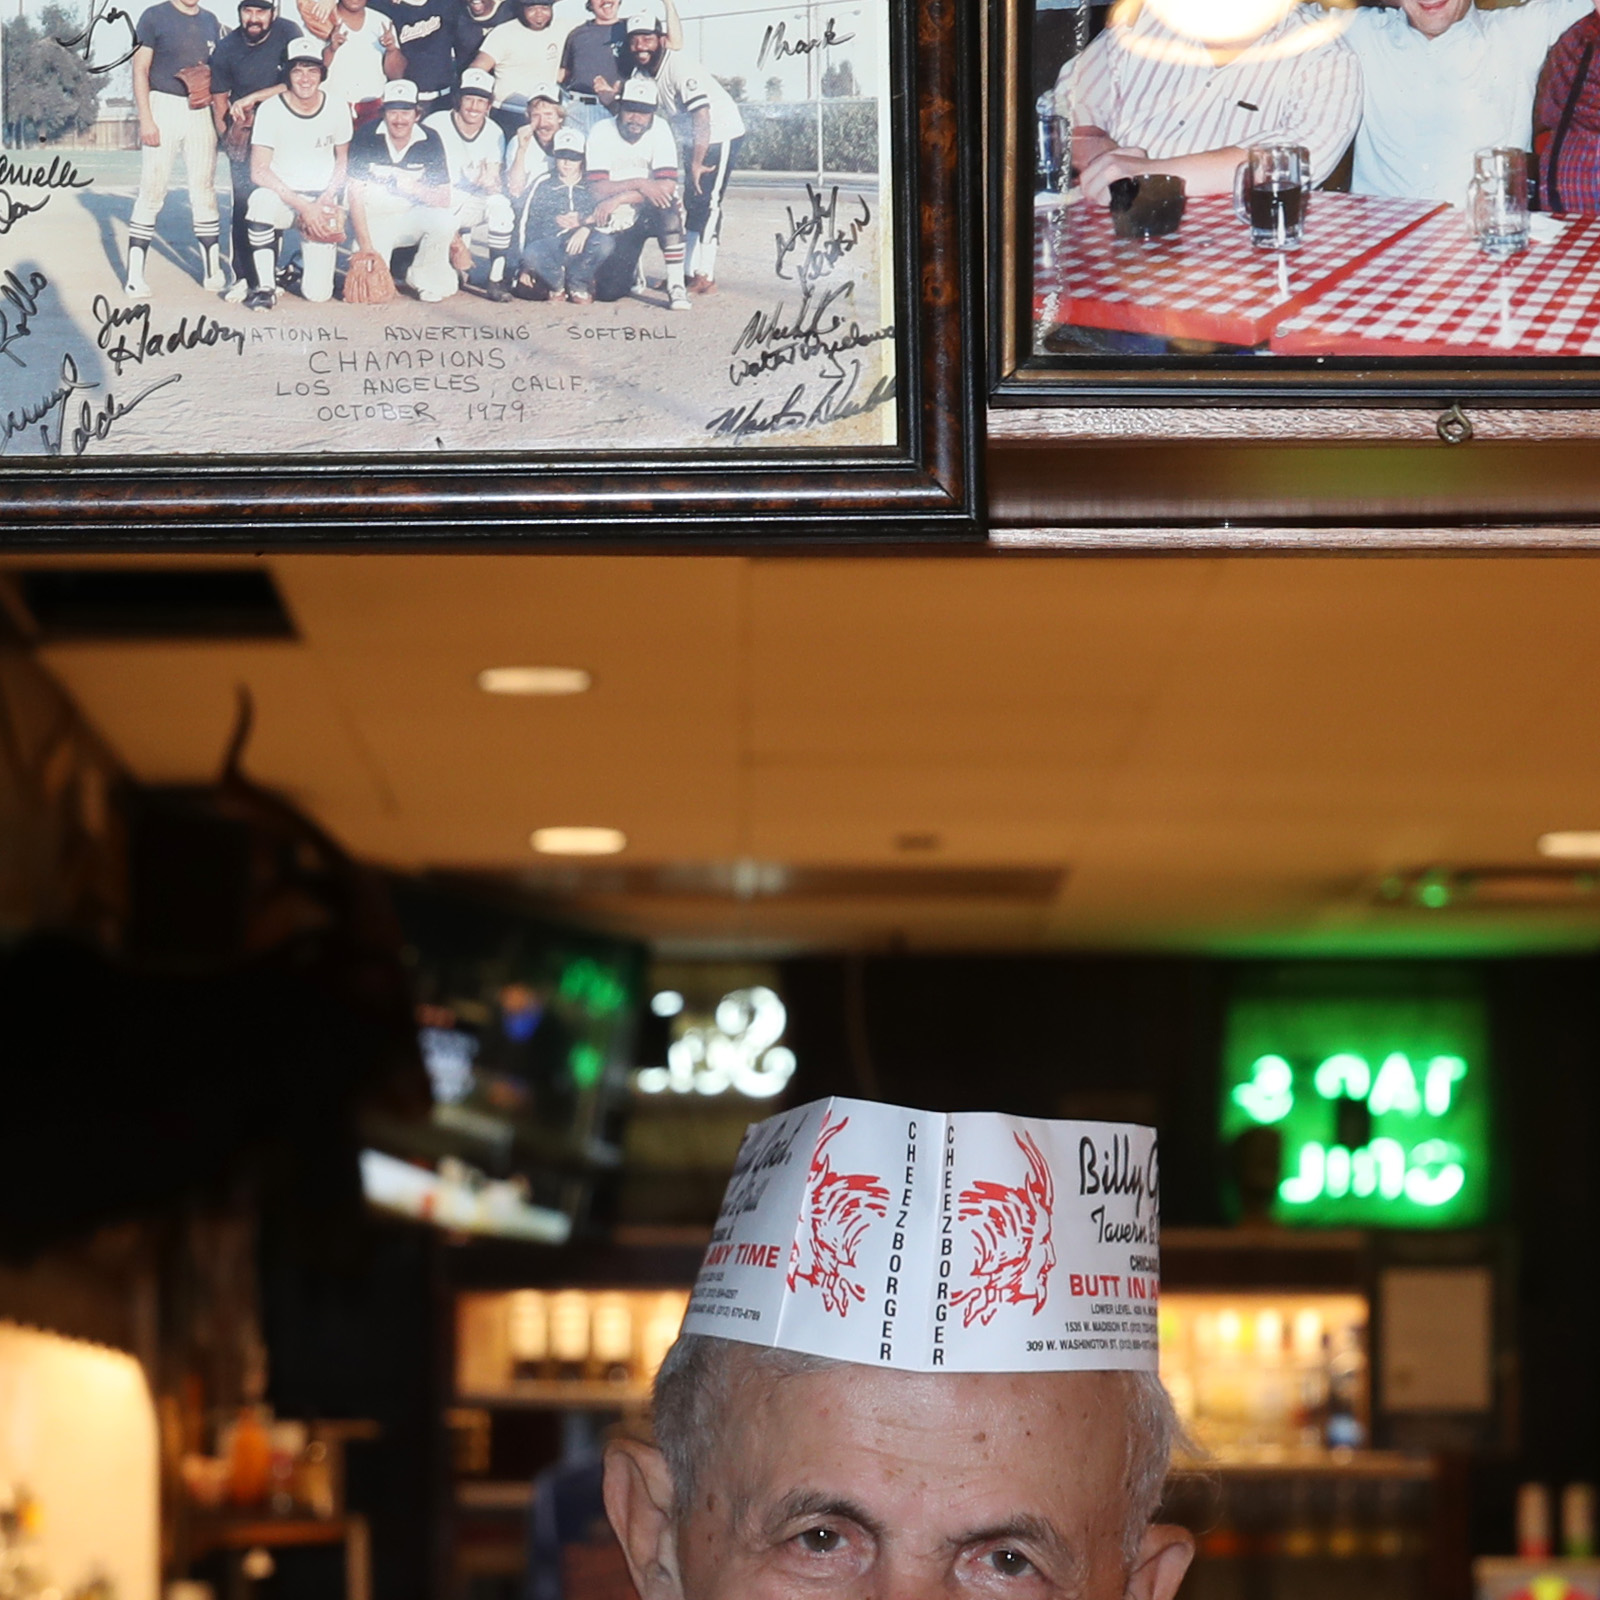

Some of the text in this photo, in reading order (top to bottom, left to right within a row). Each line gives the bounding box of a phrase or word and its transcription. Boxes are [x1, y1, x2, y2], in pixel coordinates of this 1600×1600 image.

[384, 325, 530, 341] ADVERTISING
[568, 324, 677, 341] SOFTBALL
[308, 348, 506, 375] CHAMPIONS
[276, 377, 330, 397] LOS
[317, 402, 526, 423] OCTOBER 1979
[1079, 1133, 1144, 1218] Billy
[880, 1121, 917, 1362] CHEEZBORGER
[932, 1125, 955, 1366] CHEEZBORGER
[707, 1243, 780, 1269] ANY TIME
[1069, 1273, 1121, 1297] BUTT
[1127, 1275, 1147, 1300] IN
[1026, 1340, 1044, 1351] 309
[1060, 1339, 1109, 1350] WASHINGTON
